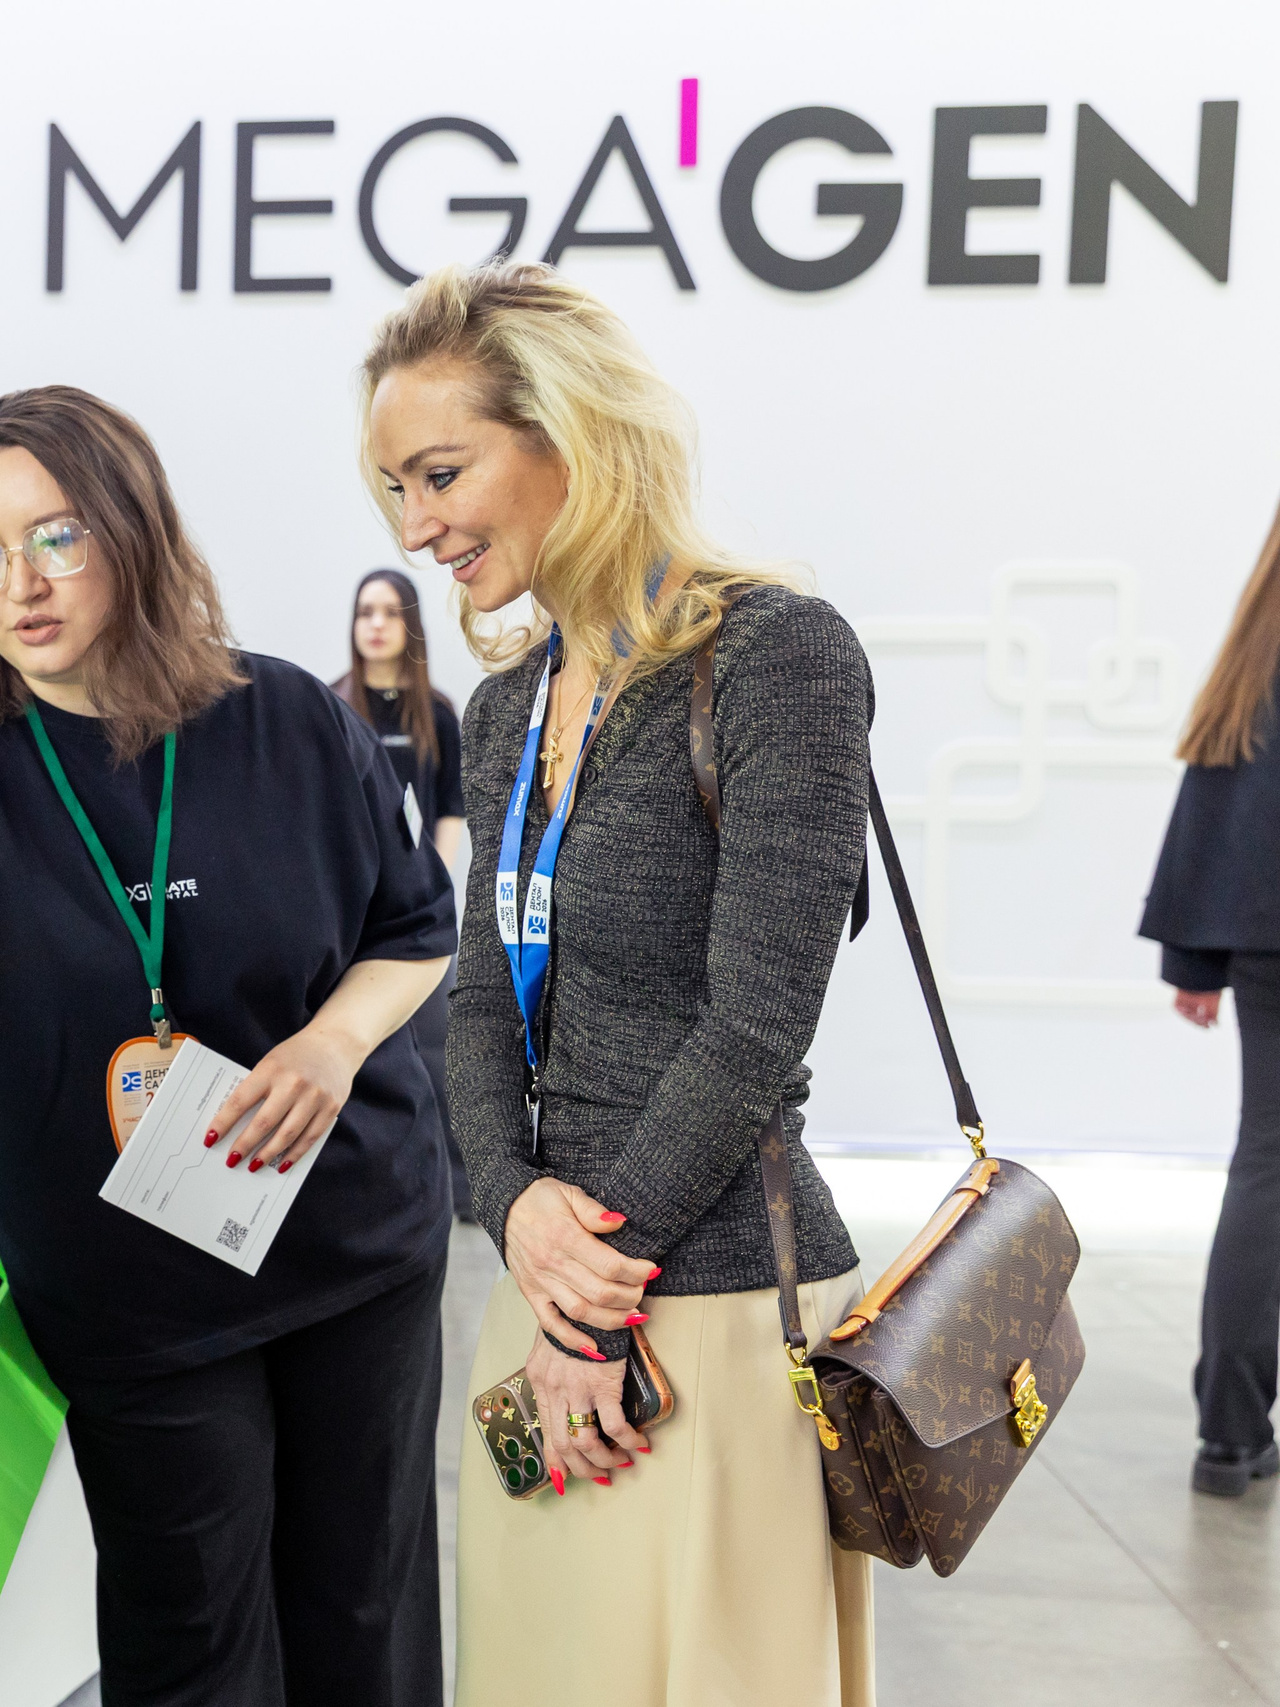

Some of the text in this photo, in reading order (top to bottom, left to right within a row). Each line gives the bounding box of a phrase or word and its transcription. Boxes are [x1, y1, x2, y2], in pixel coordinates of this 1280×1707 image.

[513, 781, 527, 817] zumax
[165, 878, 197, 893] ATE
[166, 889, 198, 900] NTAL
[529, 882, 538, 911] ДЕНТАЛ
